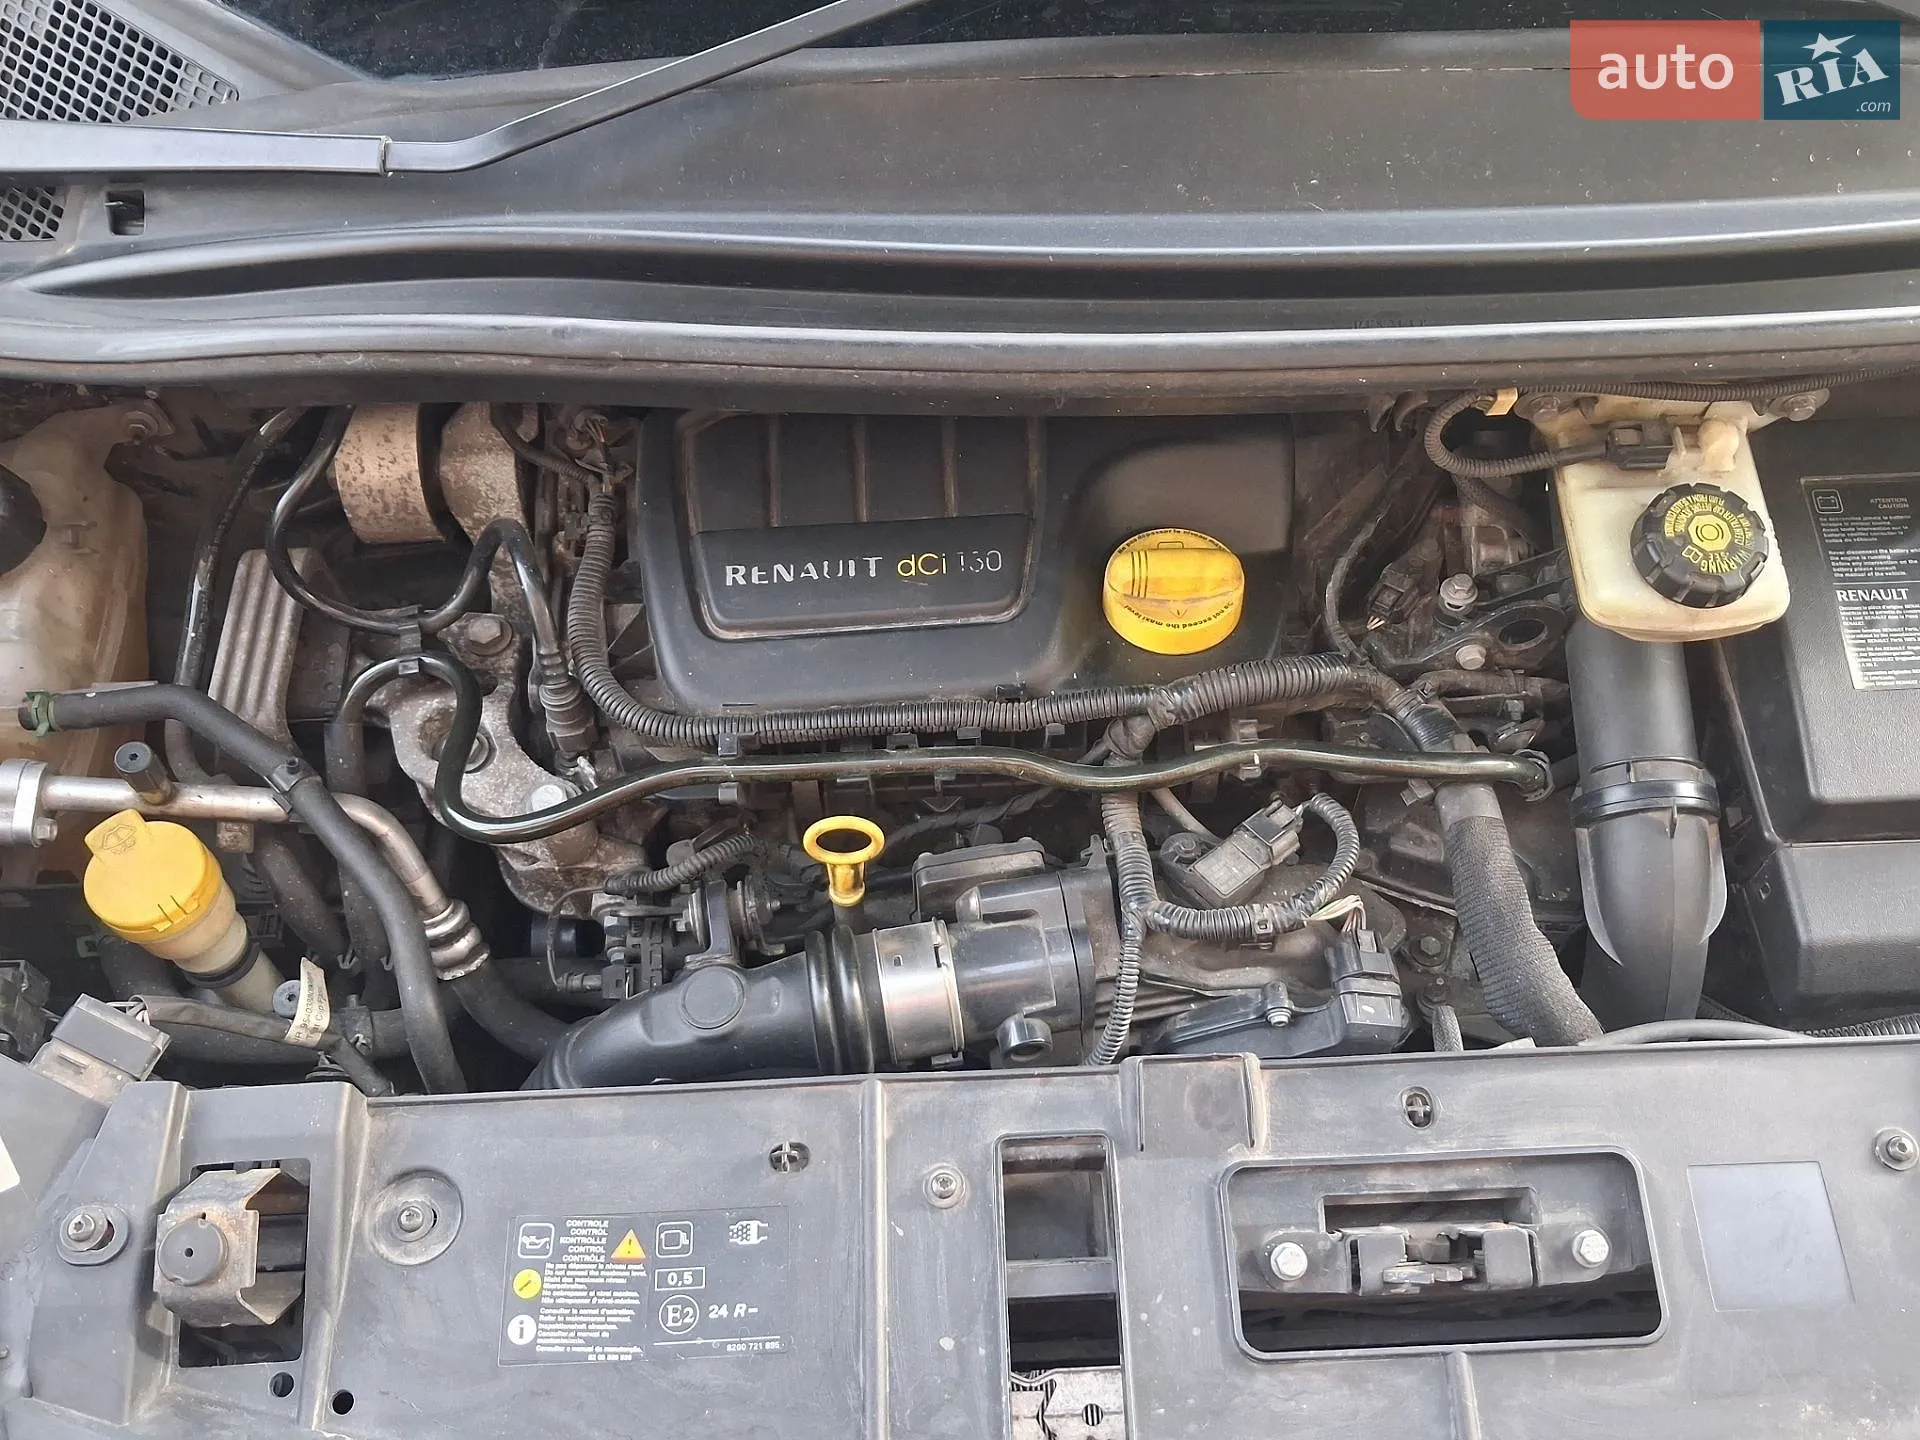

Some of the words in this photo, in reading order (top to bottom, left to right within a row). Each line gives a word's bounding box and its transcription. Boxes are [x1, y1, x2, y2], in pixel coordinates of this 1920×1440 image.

[725, 556, 883, 587] RENAULT
[897, 553, 947, 577] dCi
[1701, 549, 1751, 573] WARNING
[1836, 588, 1909, 602] RENAULT
[667, 1272, 692, 1286] 0,5
[665, 1304, 694, 1327] E2
[709, 1303, 728, 1318] 24
